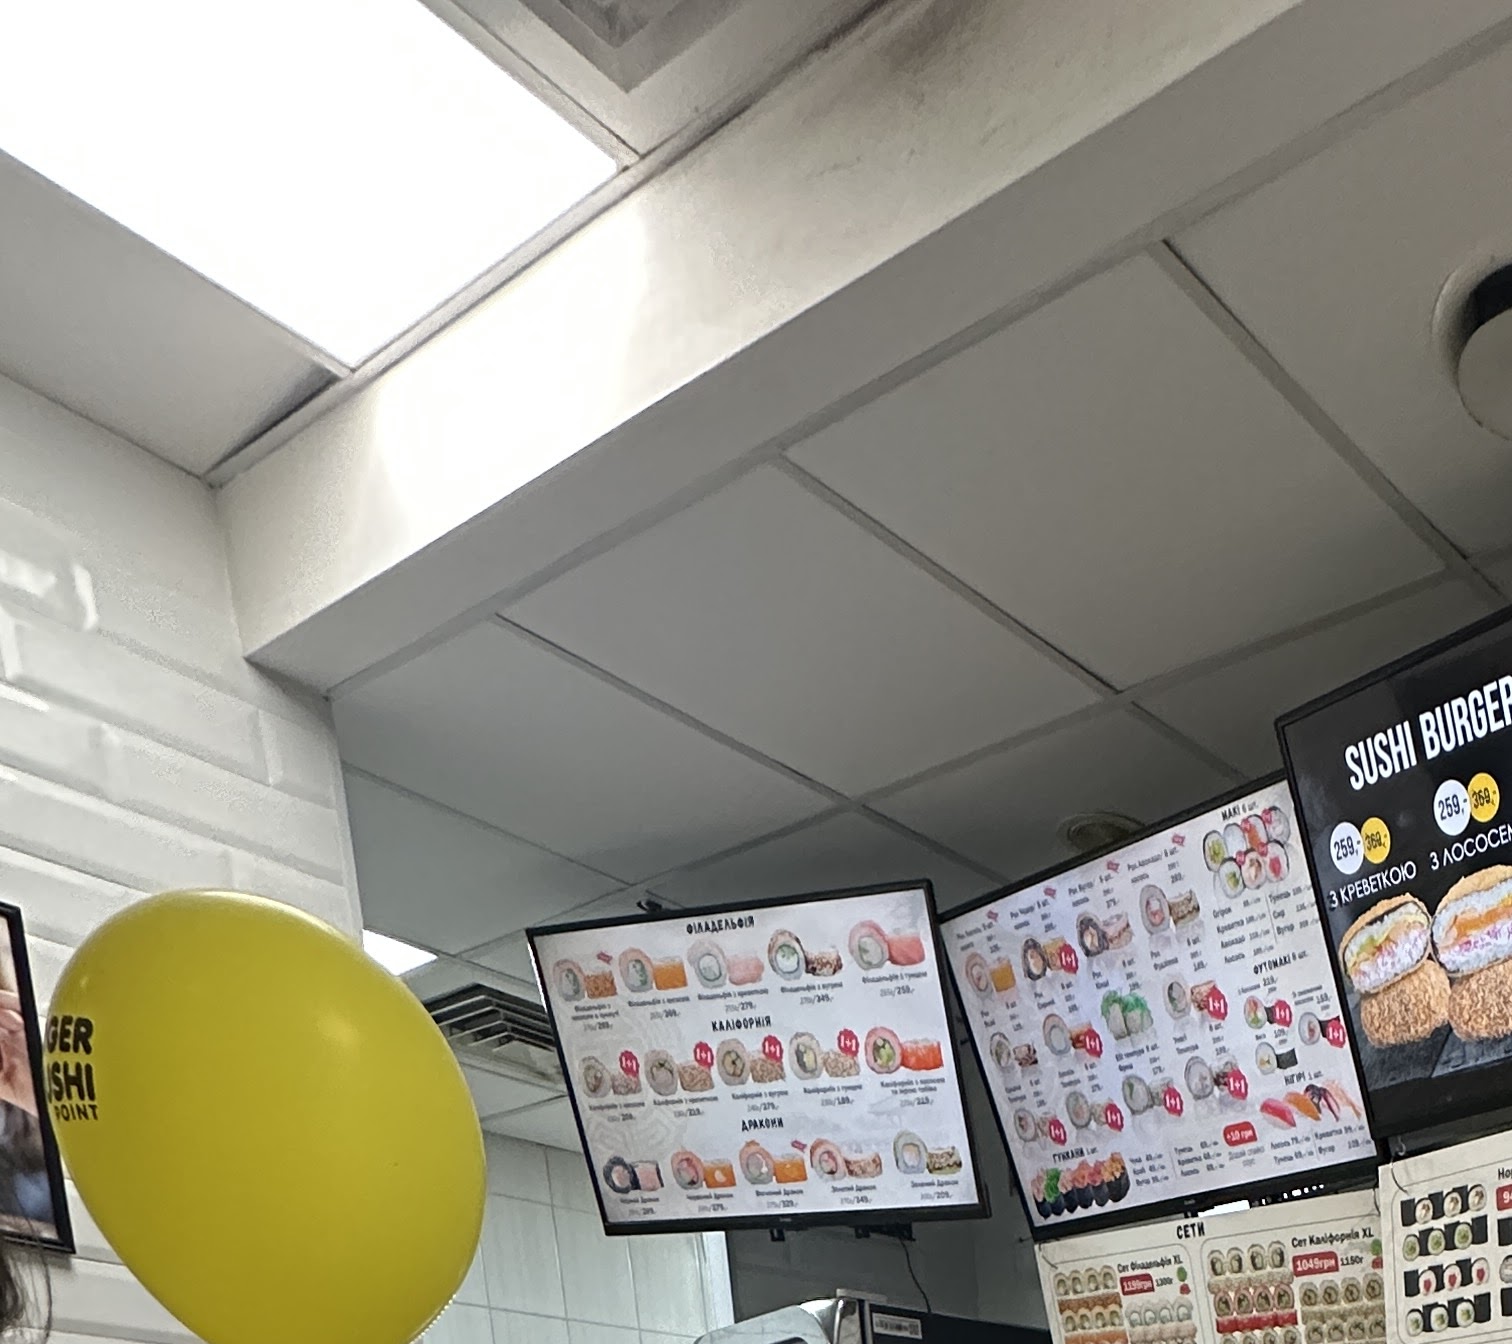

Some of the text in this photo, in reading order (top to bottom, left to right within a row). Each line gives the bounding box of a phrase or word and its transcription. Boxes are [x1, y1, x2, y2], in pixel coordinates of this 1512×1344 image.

[1345, 721, 1418, 791] SUSHI
[1340, 860, 1417, 906] КРЕВЕТКОЮ
[1177, 1222, 1205, 1239] СЕТИ
